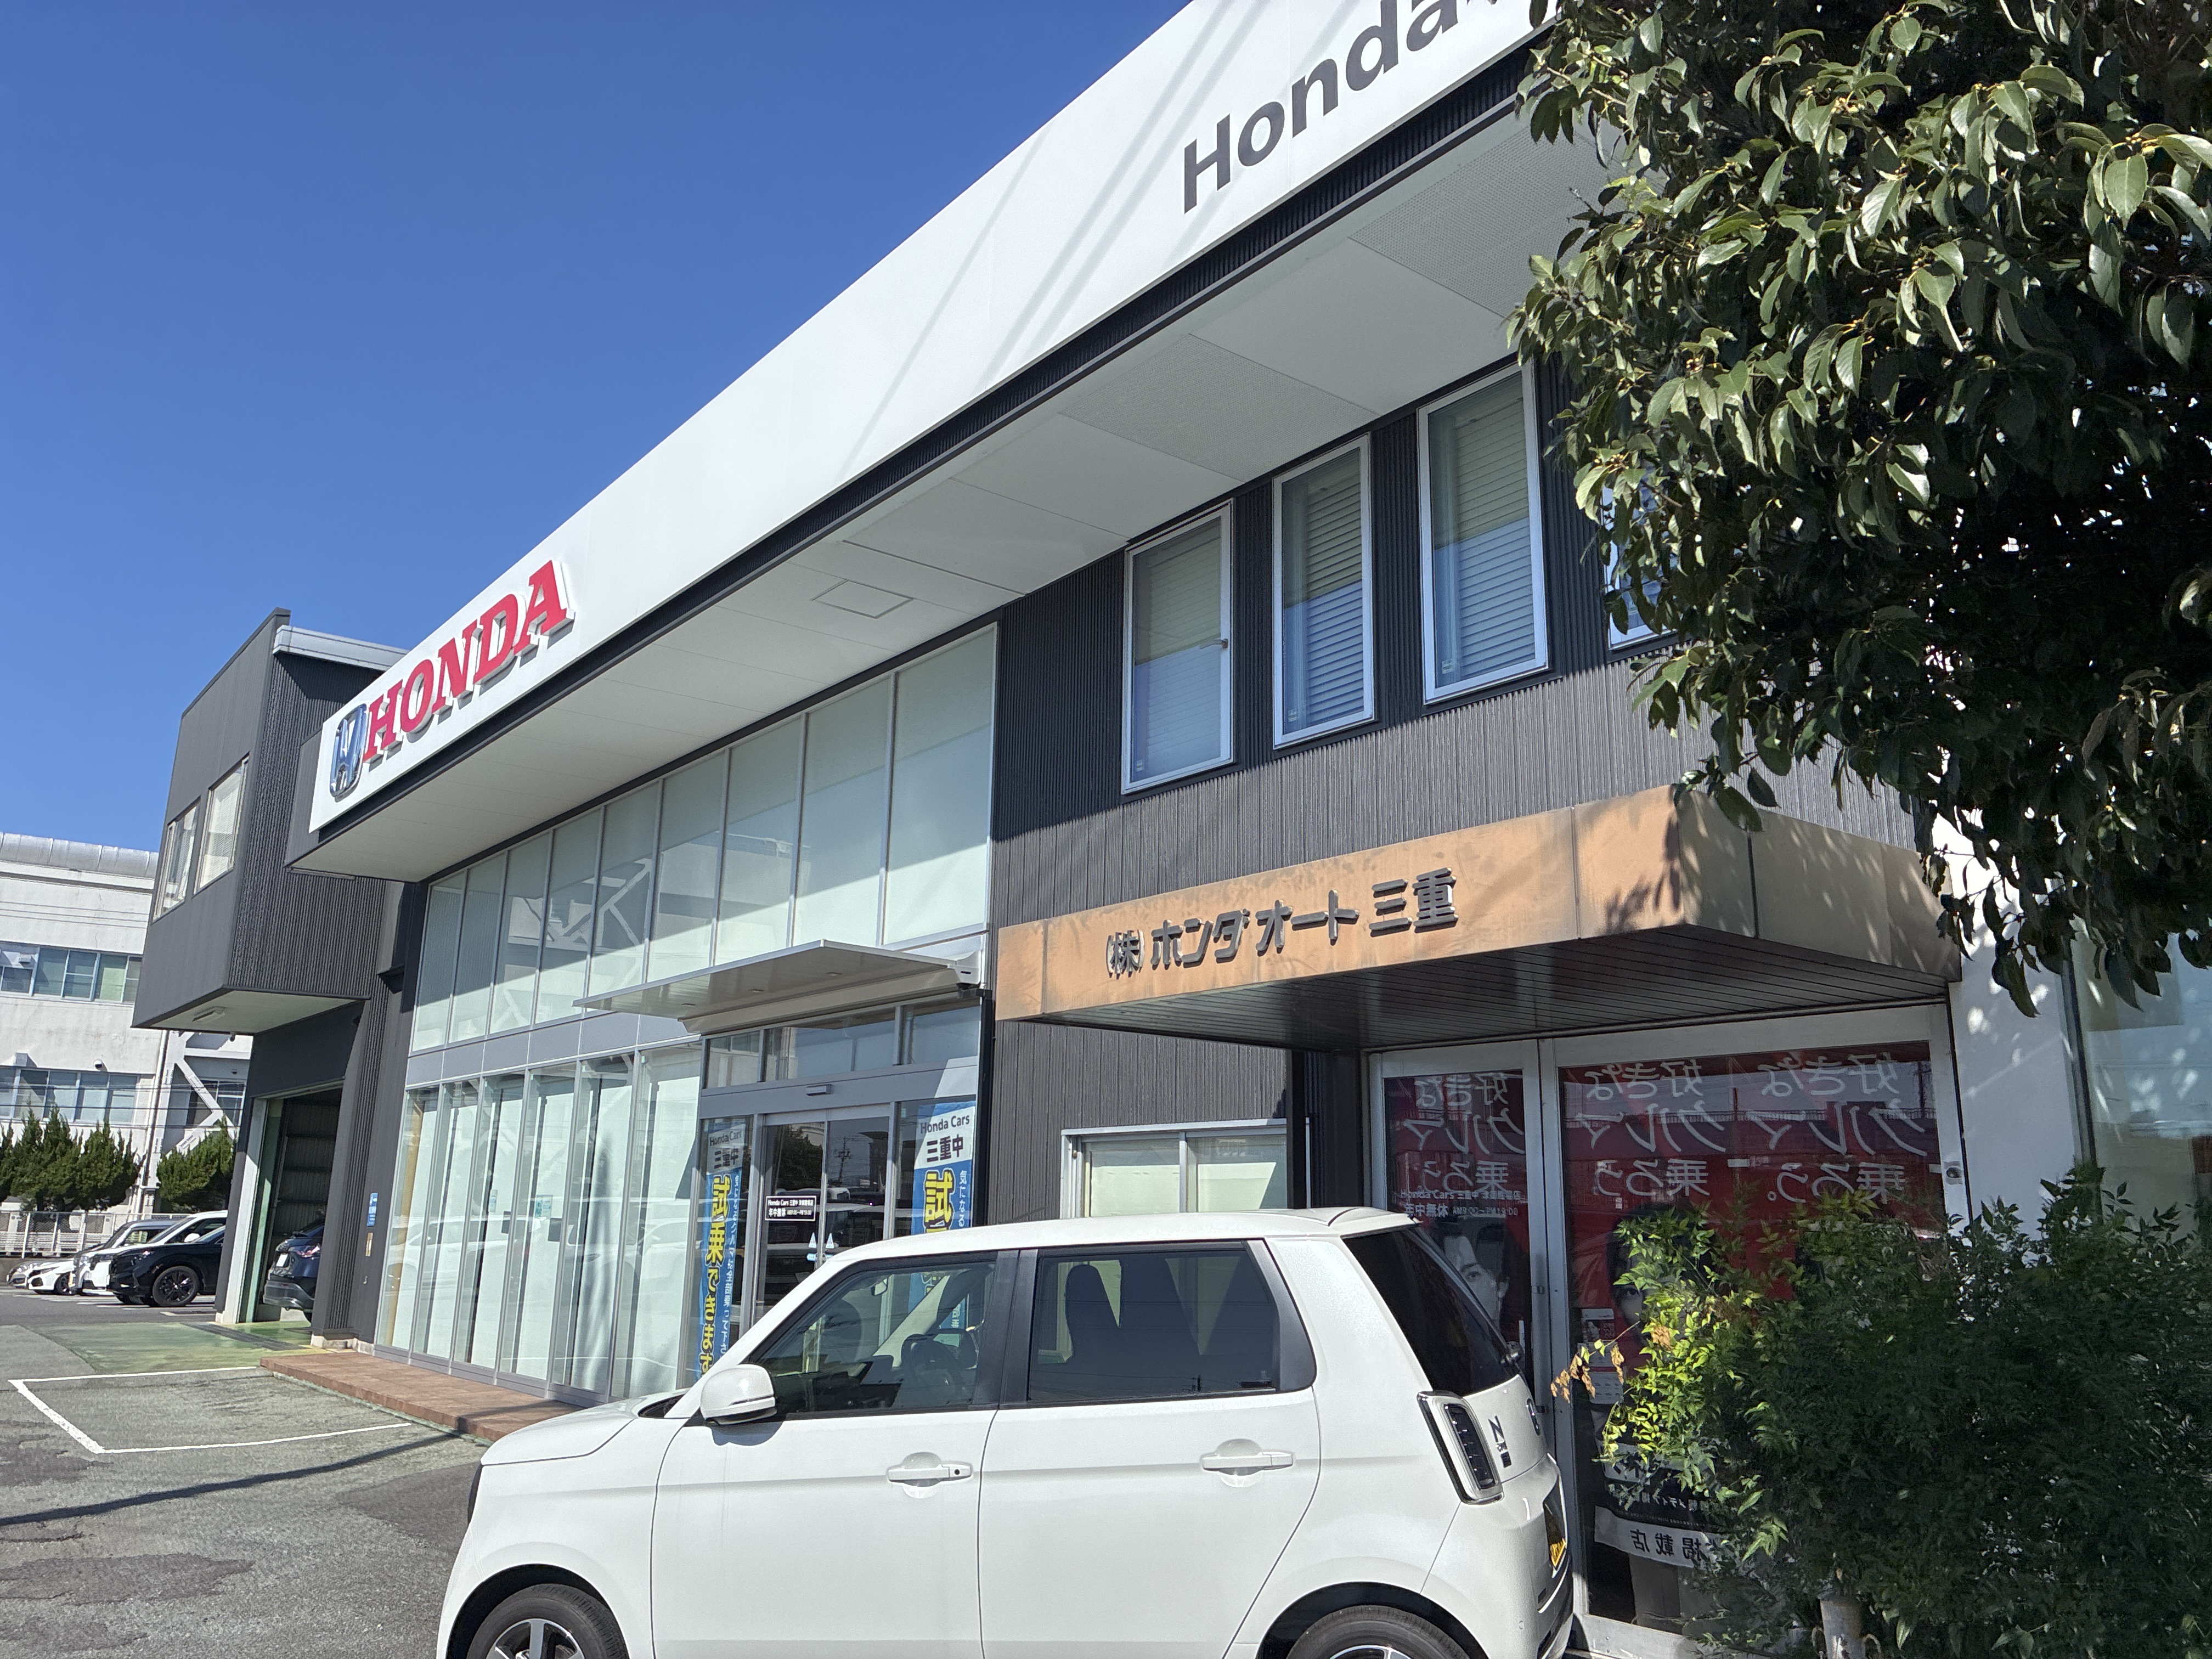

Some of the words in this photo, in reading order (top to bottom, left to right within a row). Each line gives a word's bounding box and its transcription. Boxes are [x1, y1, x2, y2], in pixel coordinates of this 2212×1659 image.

[1184, 0, 1458, 215] Honda
[363, 560, 573, 768] HONDA
[920, 1118, 949, 1134] Honda
[951, 1115, 970, 1127] Cars
[709, 1133, 729, 1147] Honda
[927, 1134, 964, 1162] 三重中
